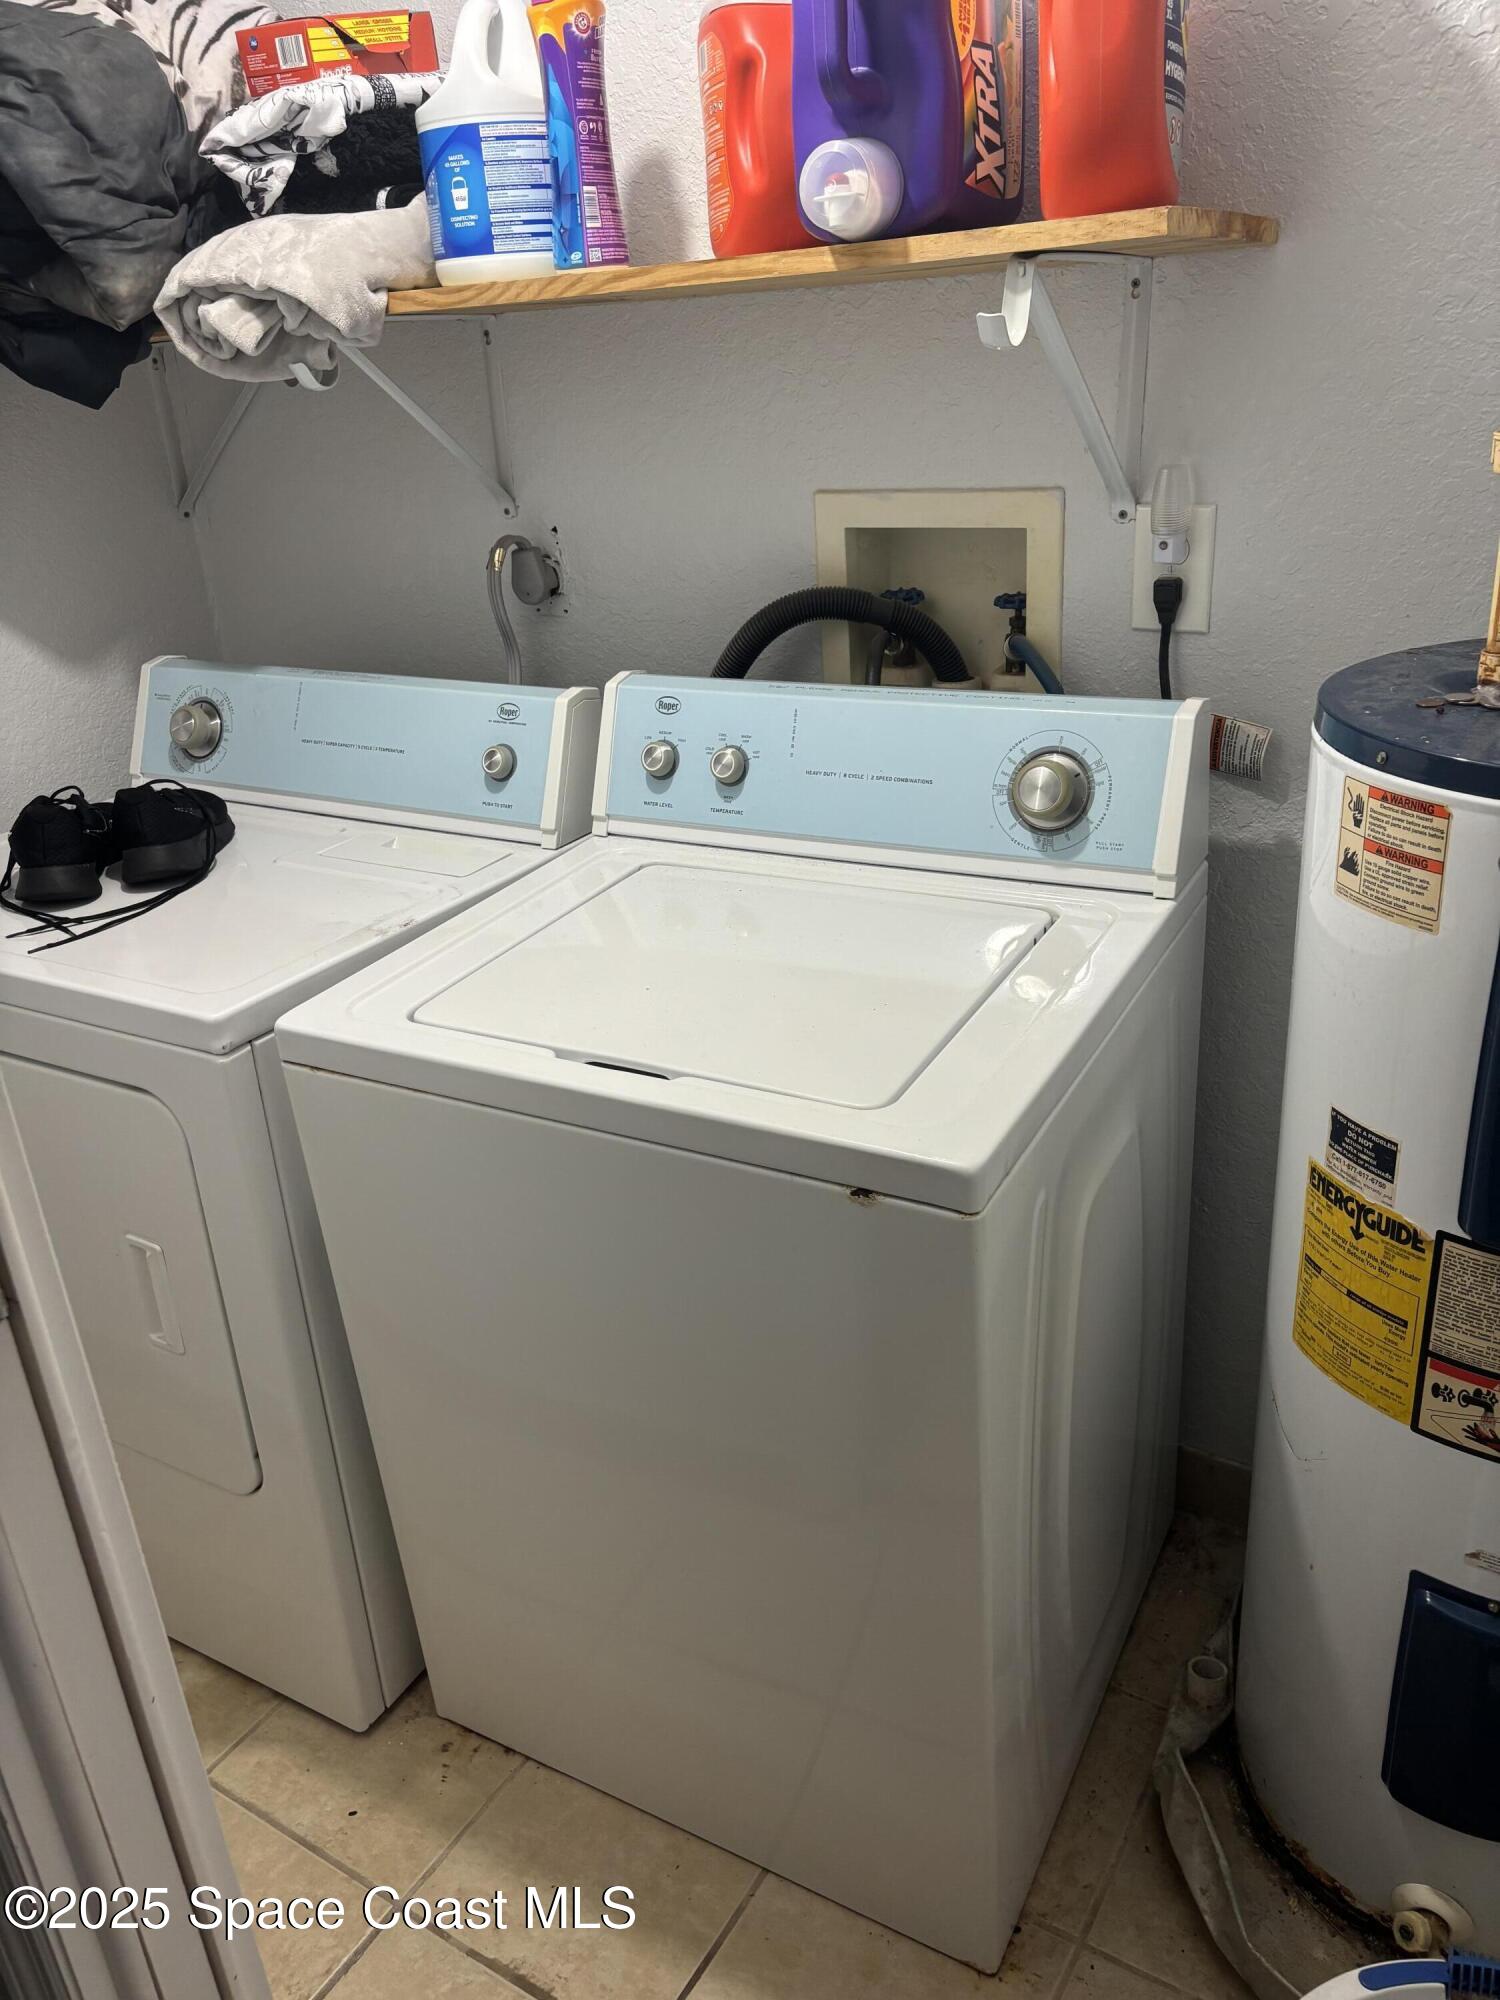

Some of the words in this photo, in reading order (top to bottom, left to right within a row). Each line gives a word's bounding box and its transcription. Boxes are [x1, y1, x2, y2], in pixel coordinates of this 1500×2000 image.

[971, 44, 1006, 198] XTRA
[499, 706, 519, 718] Roper
[658, 700, 679, 712] Roper
[893, 776, 933, 785] COMBINATIONS
[1389, 792, 1435, 815] WARNING
[710, 807, 744, 816] TEMPERATURE
[1384, 846, 1428, 869] WARNING
[1394, 864, 1411, 873] Hazard
[1381, 872, 1401, 882] approved
[1337, 1115, 1347, 1124] YOU
[1347, 1121, 1362, 1134] HAVE
[1367, 1132, 1397, 1150] PROBLEM
[1347, 1129, 1357, 1140] DO
[1358, 1136, 1374, 1149] NOT
[1341, 1142, 1357, 1154] WATER
[1363, 1147, 1375, 1158] THIS
[1343, 1150, 1357, 1161] PLACE
[1310, 1166, 1426, 1254] ENERGYGUIDE
[1330, 1235, 1347, 1251] others
[1347, 1246, 1365, 1264] Before
[1365, 1259, 1377, 1270] You
[1331, 1228, 1348, 1245] Energy
[1367, 1251, 1379, 1261] this
[1380, 1257, 1398, 1272] Water
[1399, 1268, 1421, 1282] Heater
